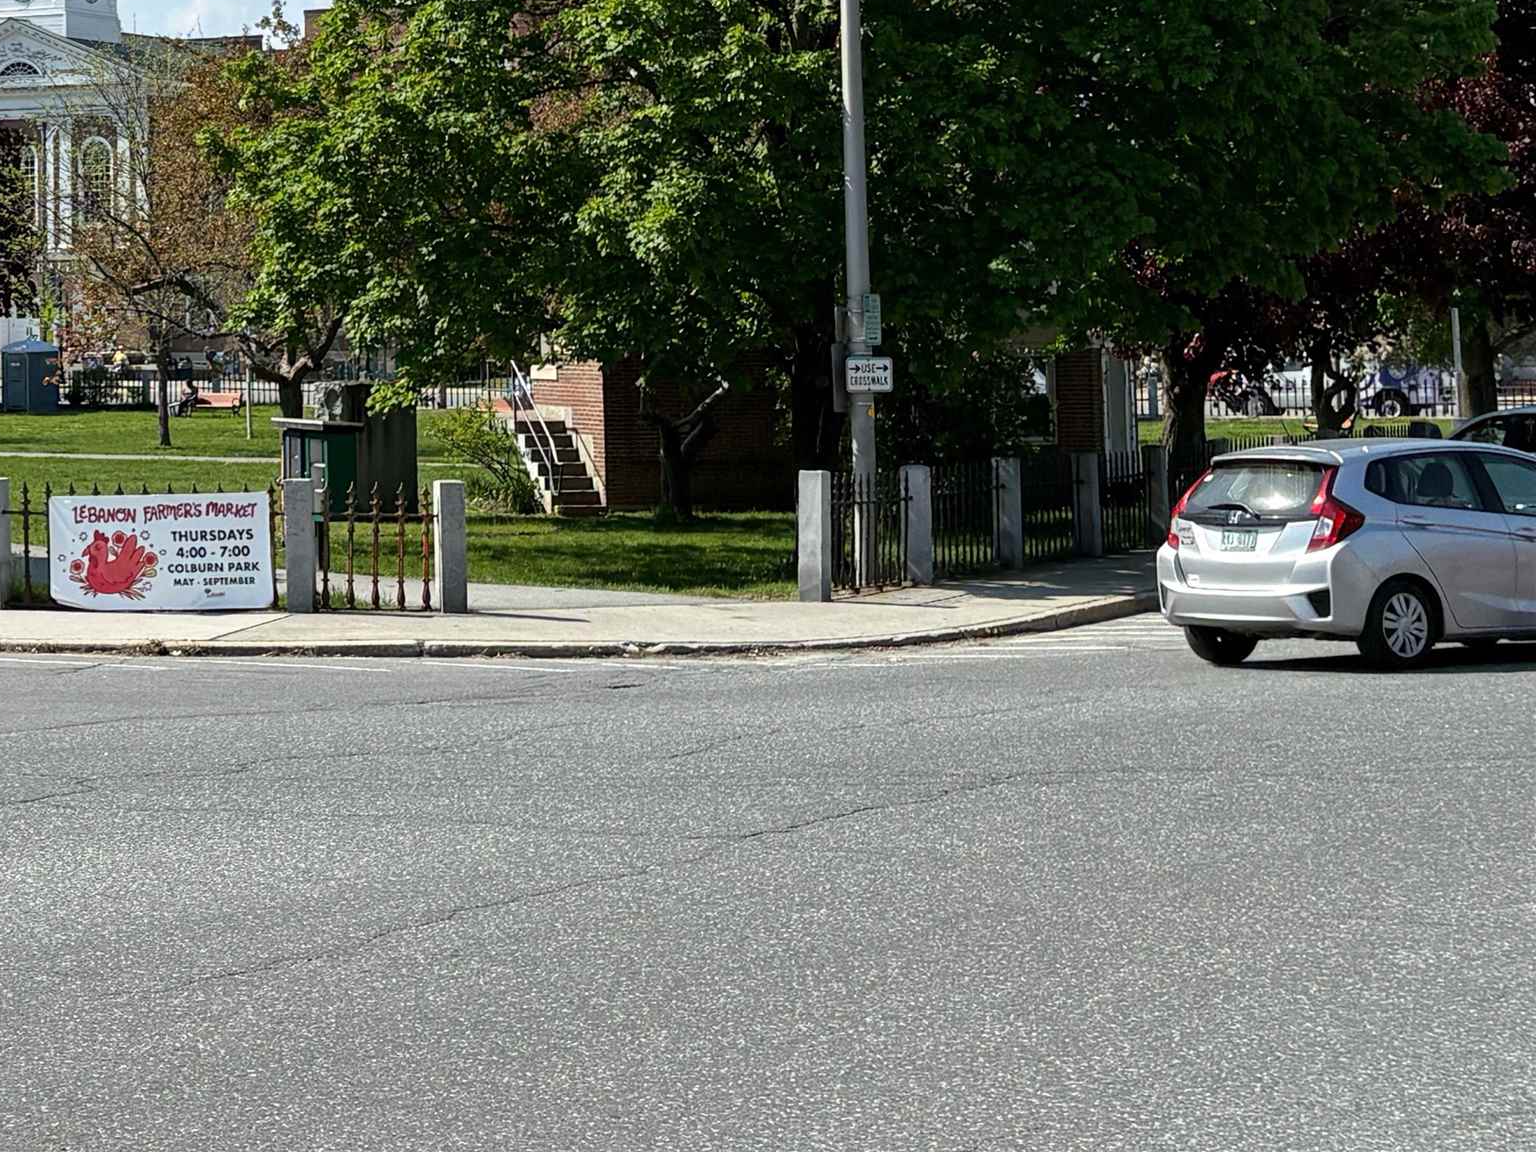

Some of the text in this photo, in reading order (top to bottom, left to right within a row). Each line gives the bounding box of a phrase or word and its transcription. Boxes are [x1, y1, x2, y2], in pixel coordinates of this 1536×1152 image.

[861, 364, 877, 374] USE
[850, 375, 889, 386] CROSSWALK
[72, 501, 258, 524] LEBANON FARMER'S MARKET
[170, 528, 254, 542] THURSDAYS
[176, 546, 207, 559] 4:00
[219, 545, 250, 558] 7:00
[167, 561, 260, 574] COLBURN PARK
[173, 577, 195, 586] MAY
[202, 576, 255, 586] SEPTEMBER
